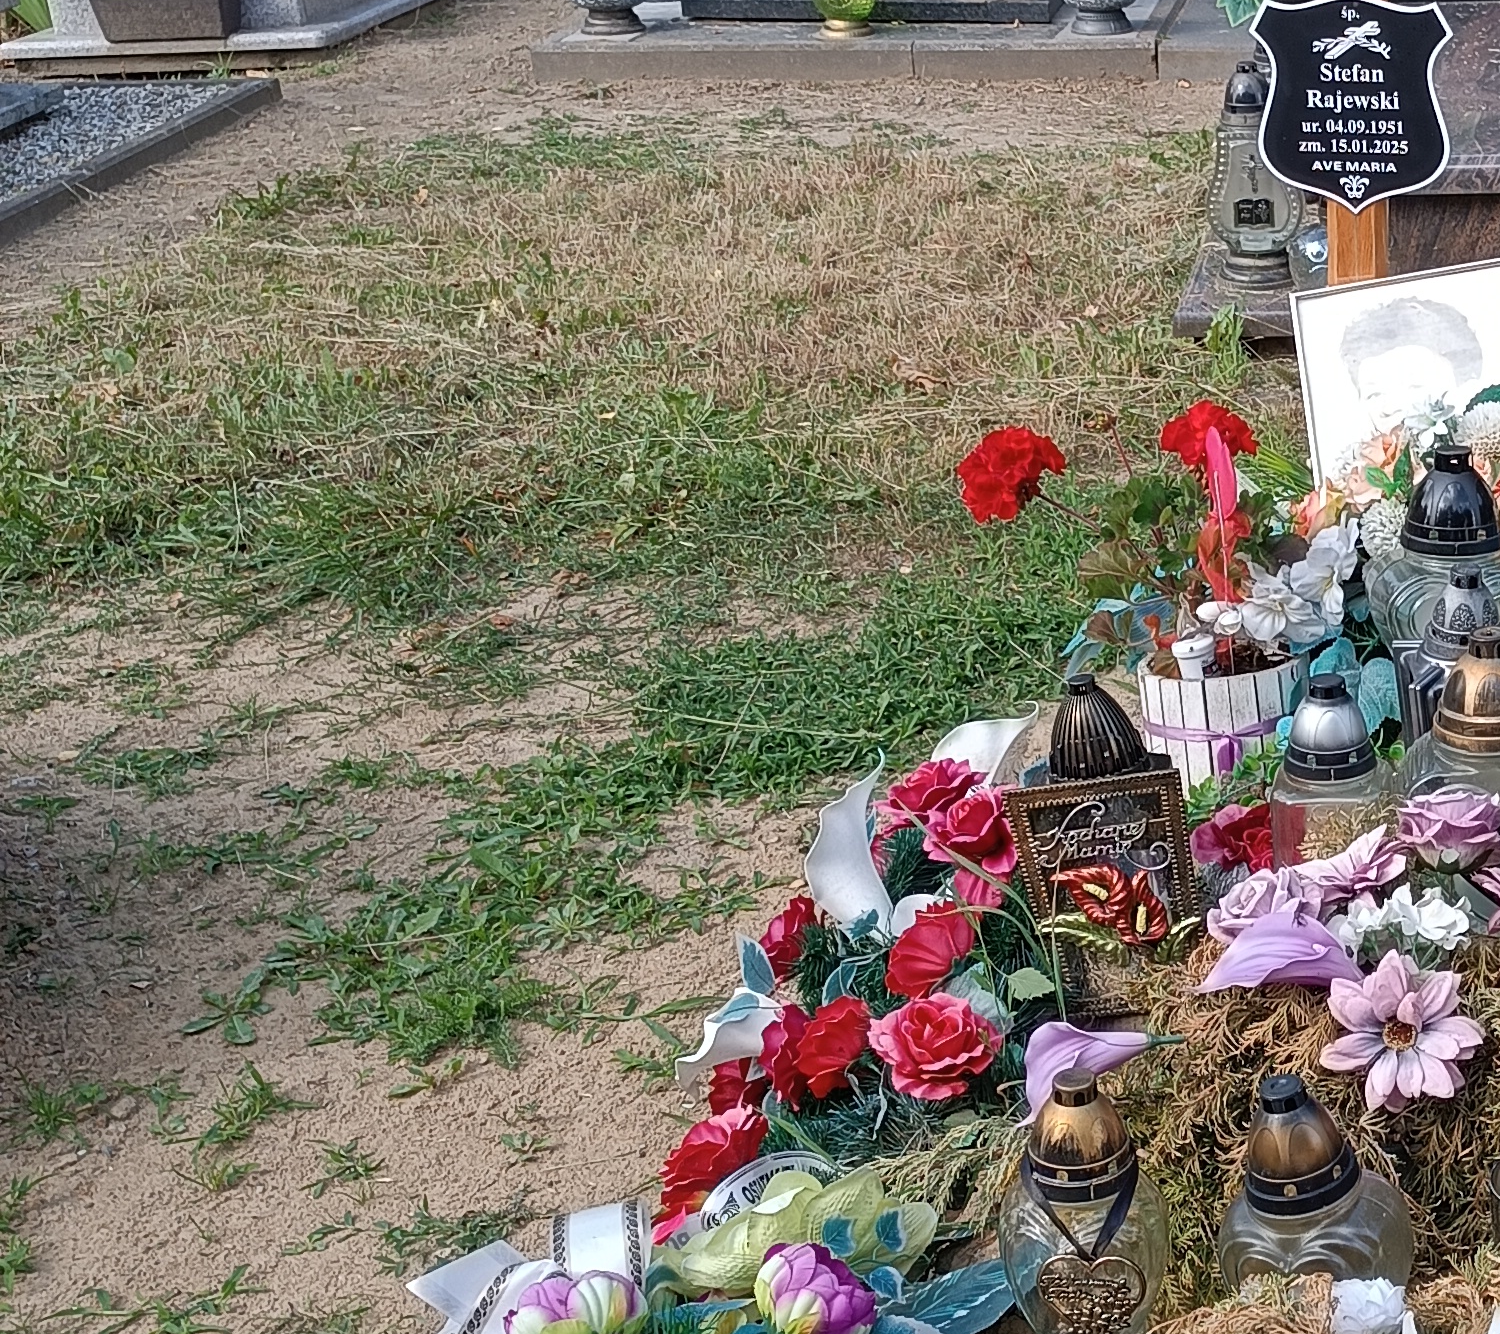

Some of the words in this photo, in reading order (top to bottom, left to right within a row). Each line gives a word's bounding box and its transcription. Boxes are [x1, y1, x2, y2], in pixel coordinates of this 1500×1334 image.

[1320, 63, 1385, 83] Stefan
[1306, 89, 1400, 113] Rajewski
[1301, 121, 1323, 133] ur.
[1326, 119, 1404, 135] 04.09.1951
[1298, 140, 1326, 152] zm.
[1330, 139, 1409, 154] 15.01.2025
[1312, 161, 1344, 171] AVE
[1345, 161, 1398, 173] MARIA
